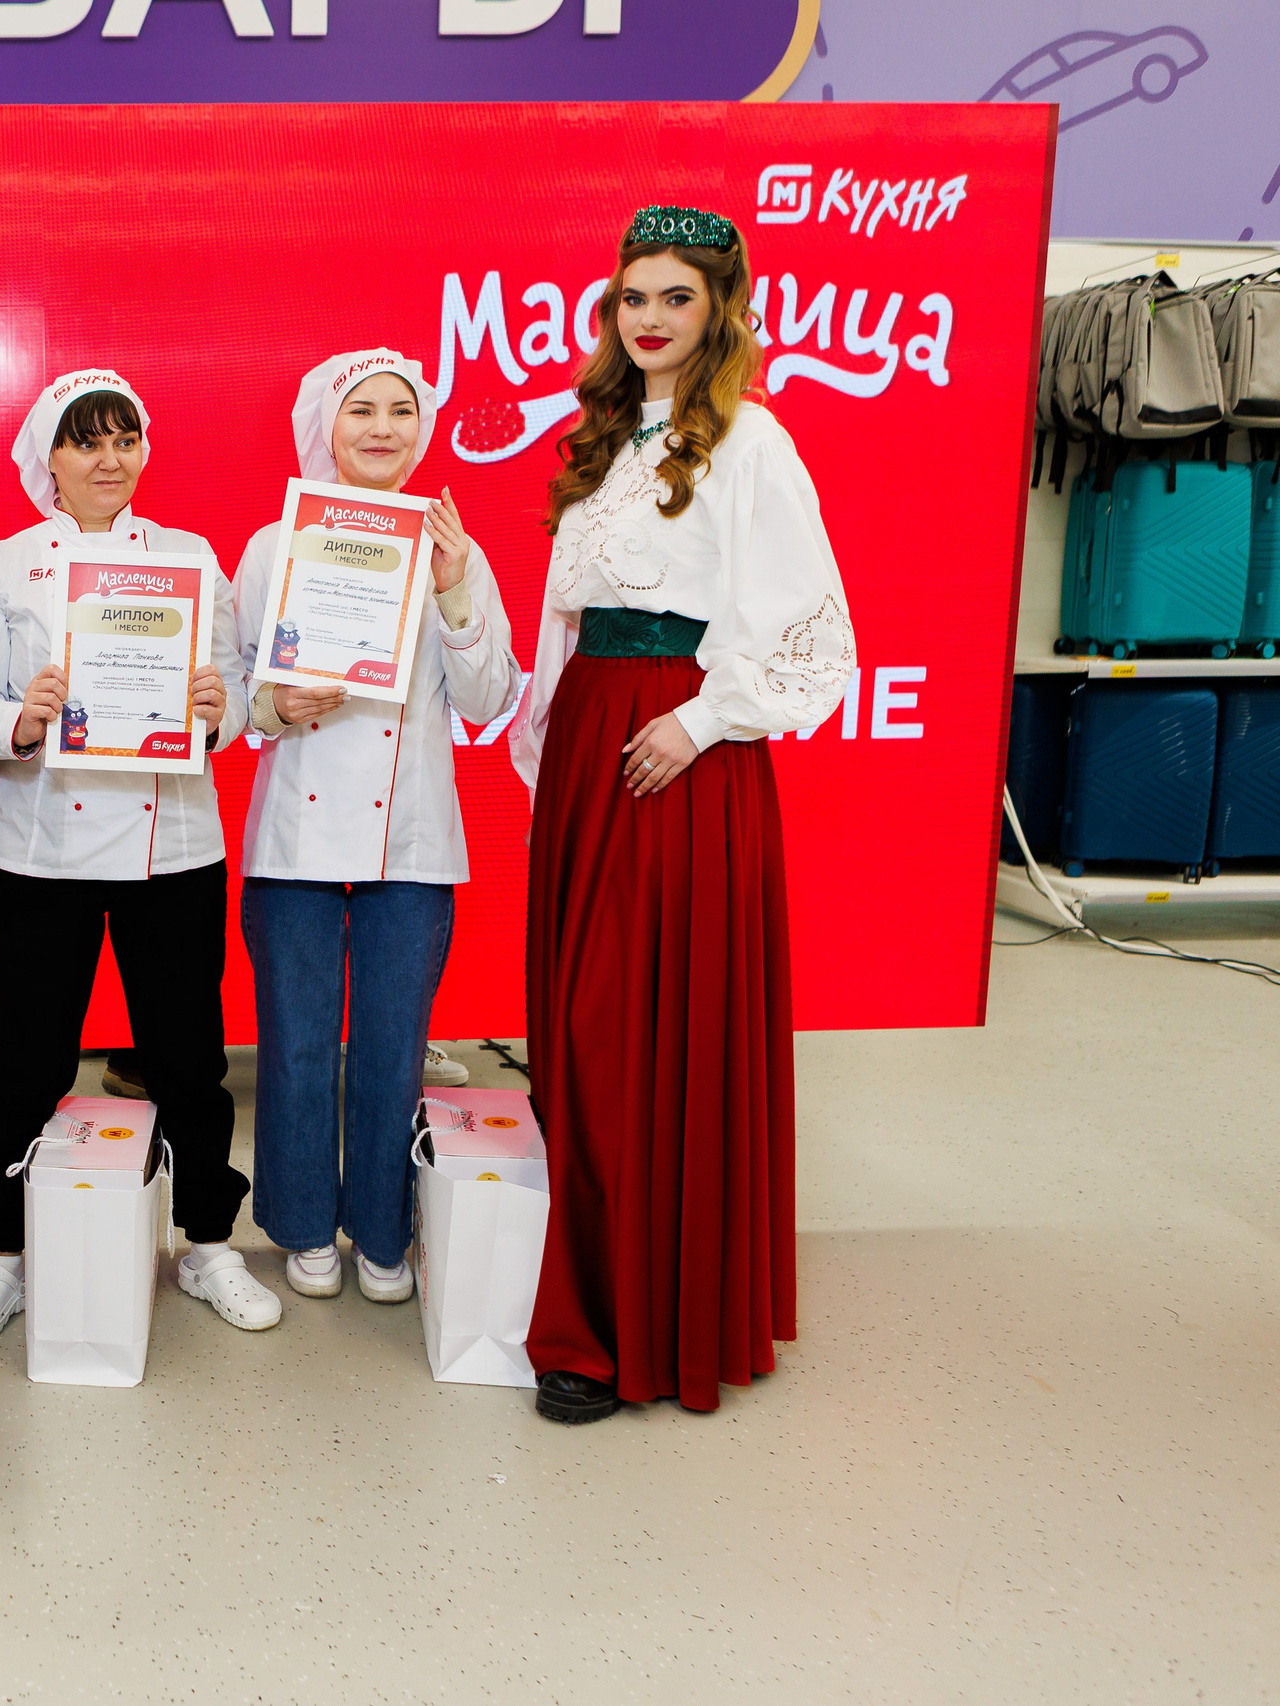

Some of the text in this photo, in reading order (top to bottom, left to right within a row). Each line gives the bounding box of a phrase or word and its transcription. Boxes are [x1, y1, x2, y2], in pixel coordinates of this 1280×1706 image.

[817, 168, 968, 238] КУХНЯ
[349, 357, 396, 377] КУХНЯ
[74, 375, 122, 388] КУХНЯ
[321, 505, 397, 531] Масленица
[323, 540, 384, 558] ДИПЛОМ
[339, 556, 368, 566] МЕСТО
[95, 571, 174, 593] Масленица
[101, 609, 164, 622] ДИПЛОМ
[119, 624, 149, 632] МЕСТО
[162, 741, 186, 752] КУХНЯ
